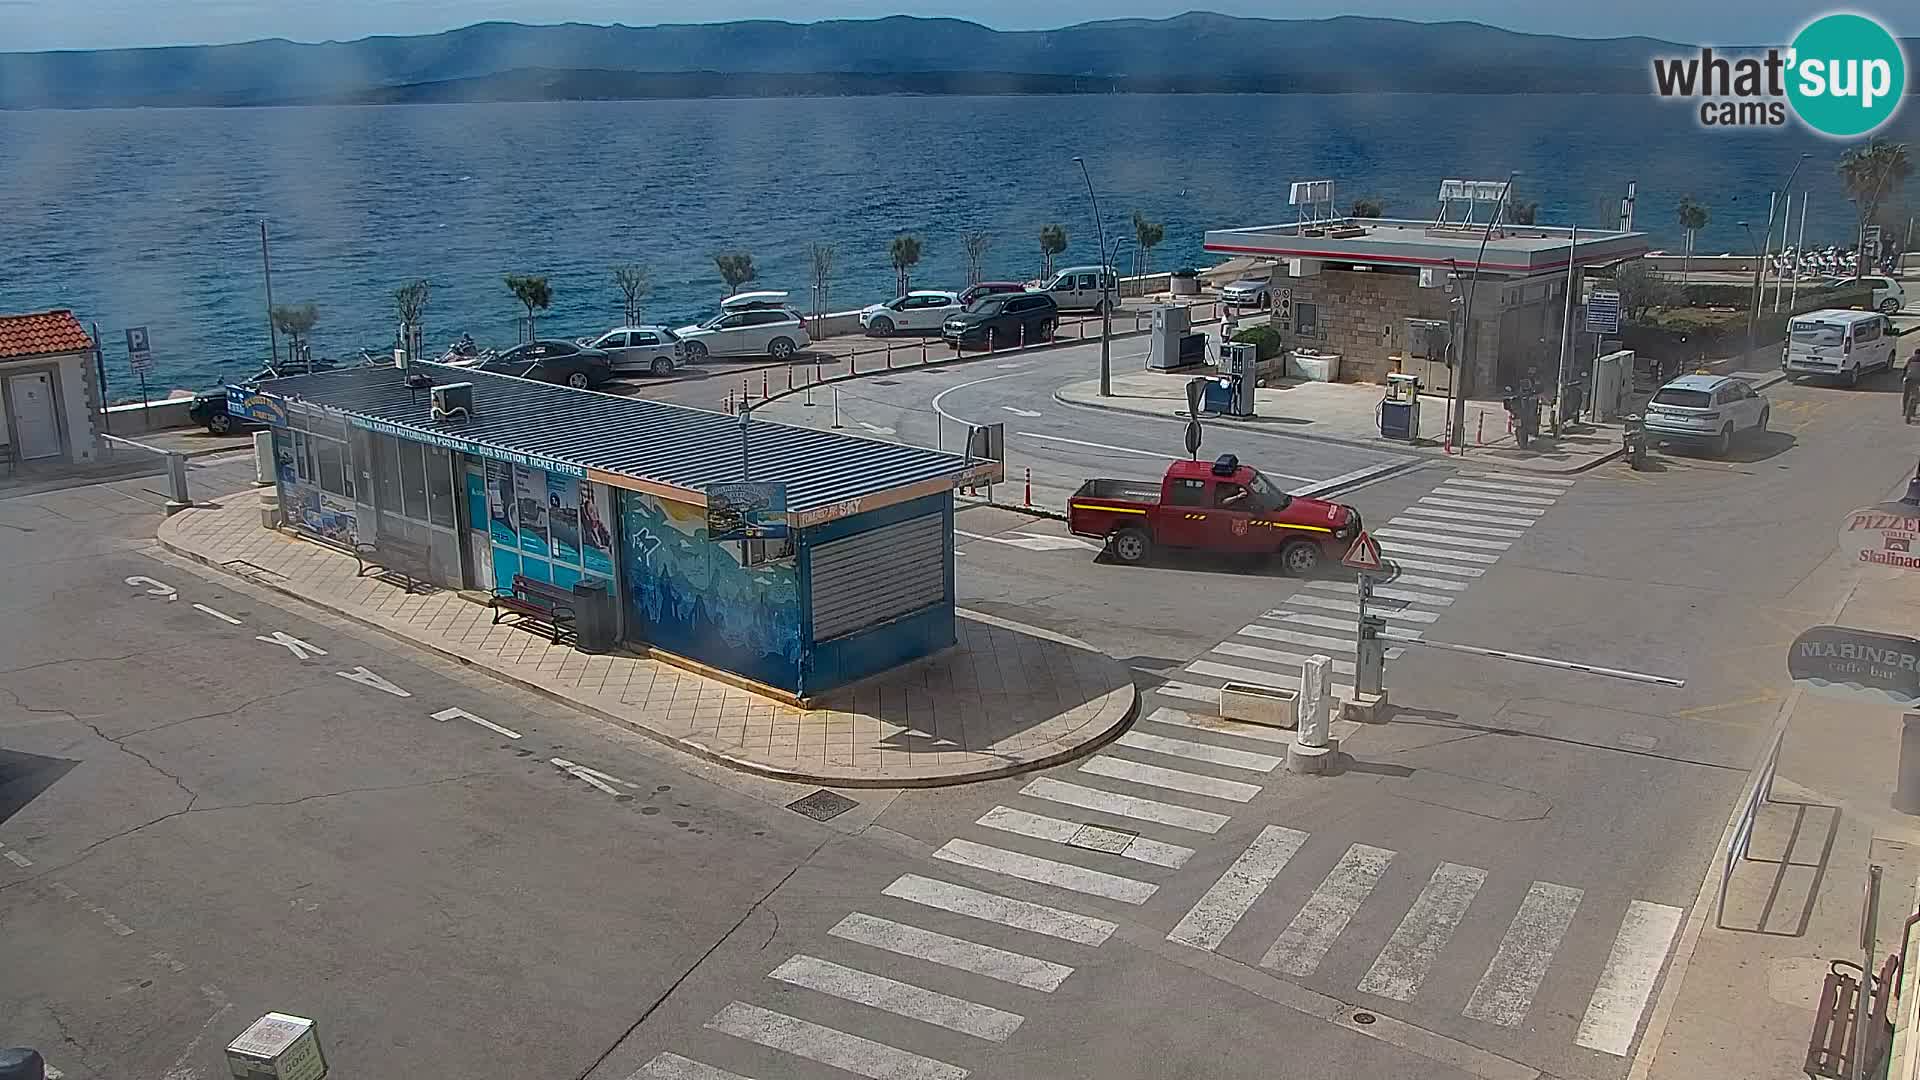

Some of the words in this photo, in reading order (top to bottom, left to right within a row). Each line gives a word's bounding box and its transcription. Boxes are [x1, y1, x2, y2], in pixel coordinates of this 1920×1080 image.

[131, 330, 143, 348] P
[438, 437, 469, 451] POSTAJA
[479, 446, 494, 457] BUS
[494, 449, 527, 464] STATION
[529, 457, 555, 470] TICKET
[556, 463, 583, 476] OFFICE
[1848, 515, 1920, 533] PIZZE
